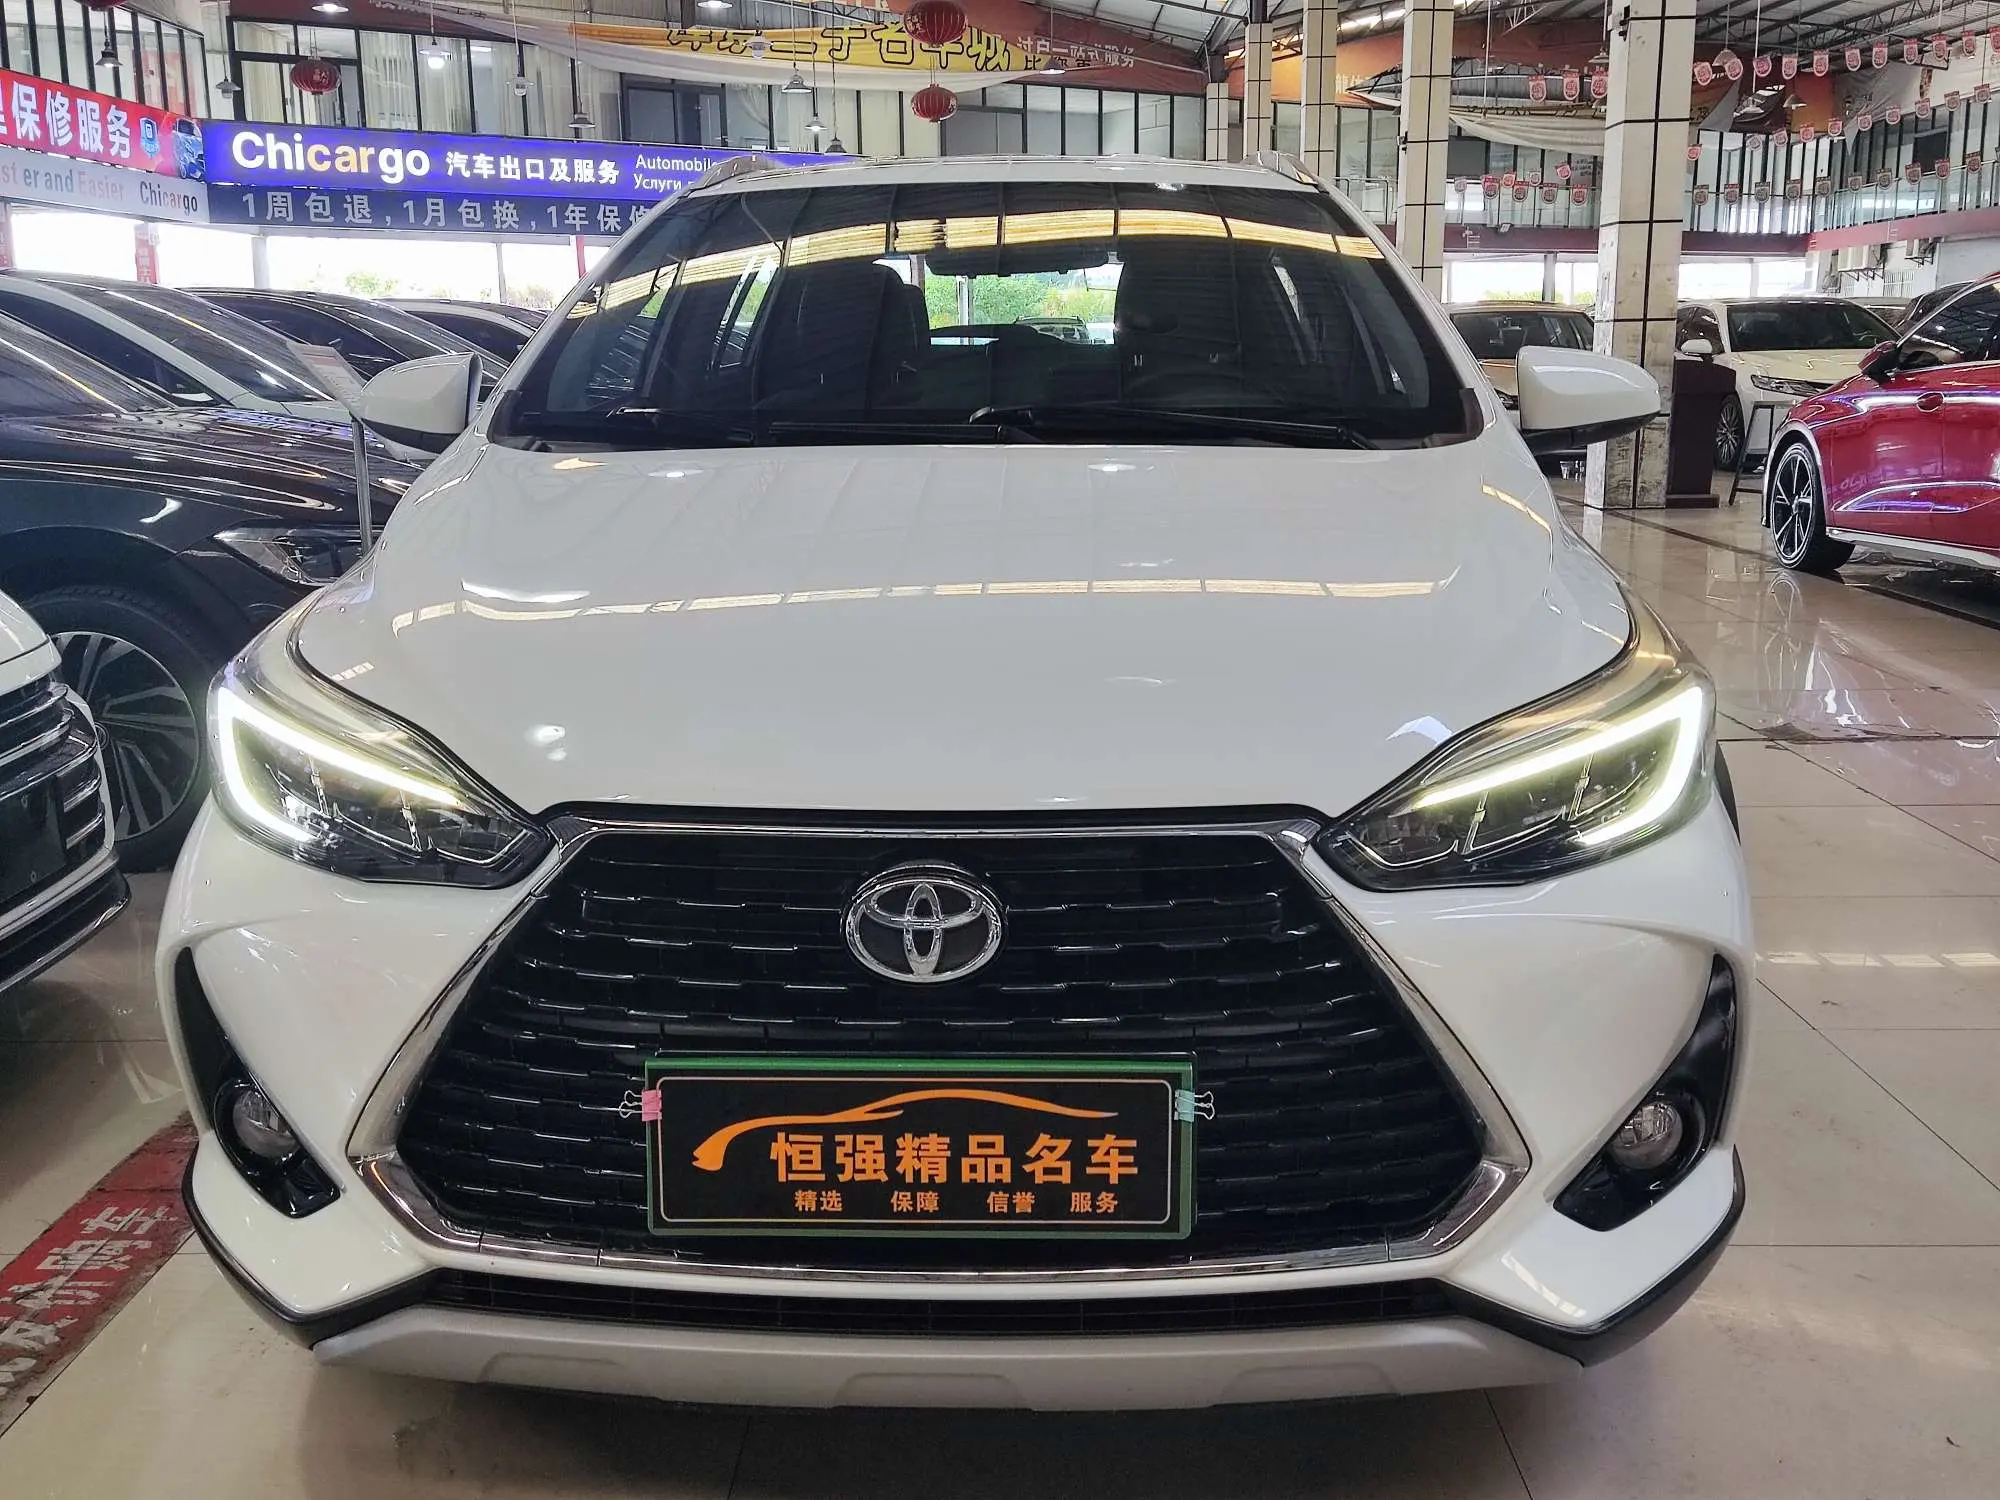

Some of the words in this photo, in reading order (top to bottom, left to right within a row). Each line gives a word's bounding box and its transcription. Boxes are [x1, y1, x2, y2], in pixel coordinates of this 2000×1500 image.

[0, 80, 132, 159] 保修服务
[231, 131, 431, 185] Chicargo
[445, 151, 620, 185] 汽车出口及服务
[139, 180, 198, 217] Chicargo
[633, 173, 682, 193] Услуги
[770, 1132, 1138, 1184] 恒强精品名车
[794, 1190, 844, 1213] 精选
[890, 1190, 940, 1213] 保障
[986, 1190, 1036, 1213] 信誉
[1069, 1190, 1119, 1213] 服务
